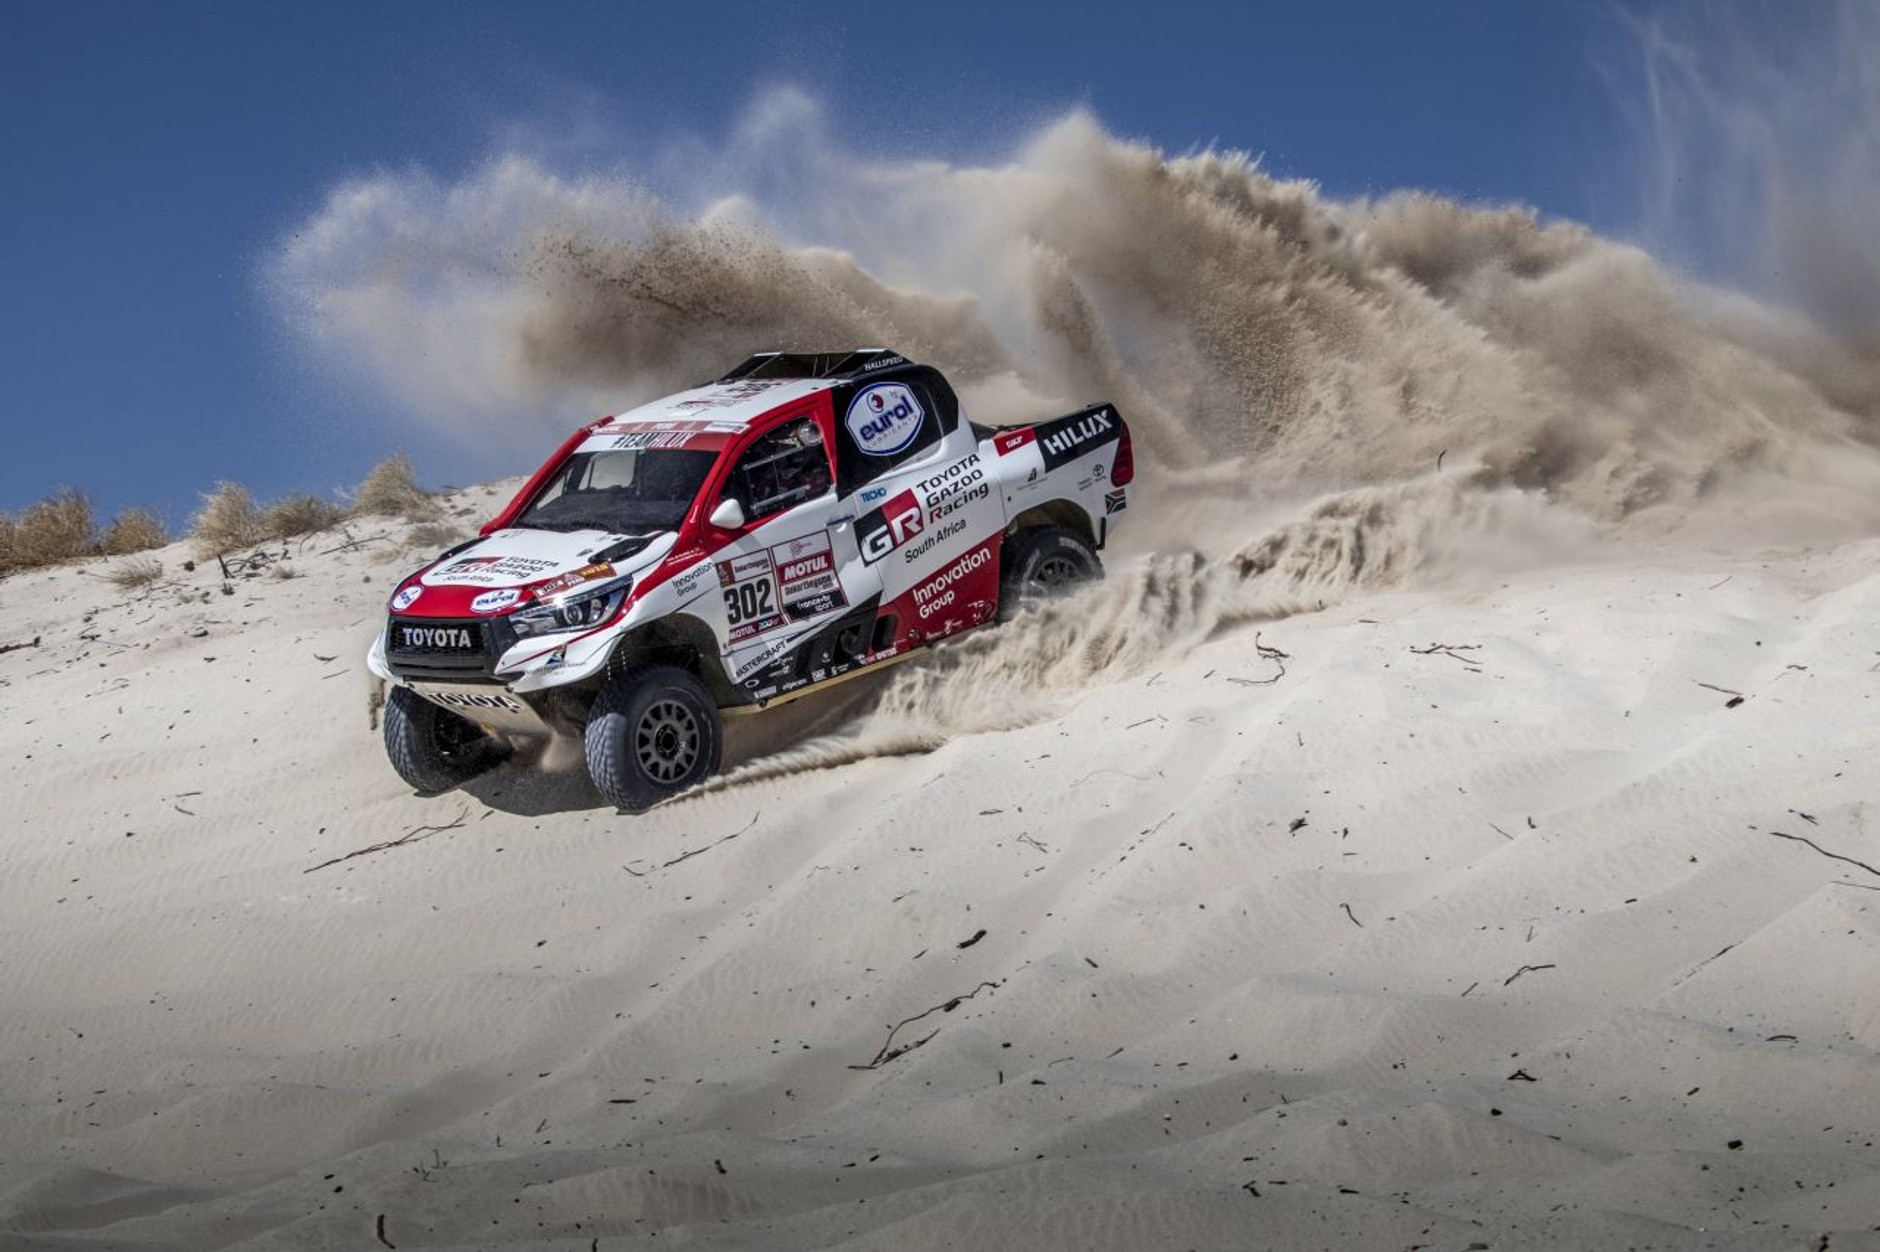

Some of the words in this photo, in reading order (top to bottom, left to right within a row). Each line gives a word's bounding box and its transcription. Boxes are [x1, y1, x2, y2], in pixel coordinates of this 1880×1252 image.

[860, 396, 915, 441] eurol
[1043, 409, 1113, 456] HILUX
[917, 453, 981, 493] TOYOTA
[926, 469, 983, 508] GAZOO
[929, 482, 990, 524] Racing
[860, 506, 923, 563] GR
[904, 536, 936, 563] South
[936, 519, 967, 545] Africa
[672, 562, 715, 589] Innovation
[784, 555, 828, 580] MOTUL
[913, 548, 991, 605] Innovation
[724, 578, 773, 625] 302
[919, 590, 955, 619] Group
[402, 628, 471, 647] TOYOTA
[730, 624, 756, 639] MOTUL
